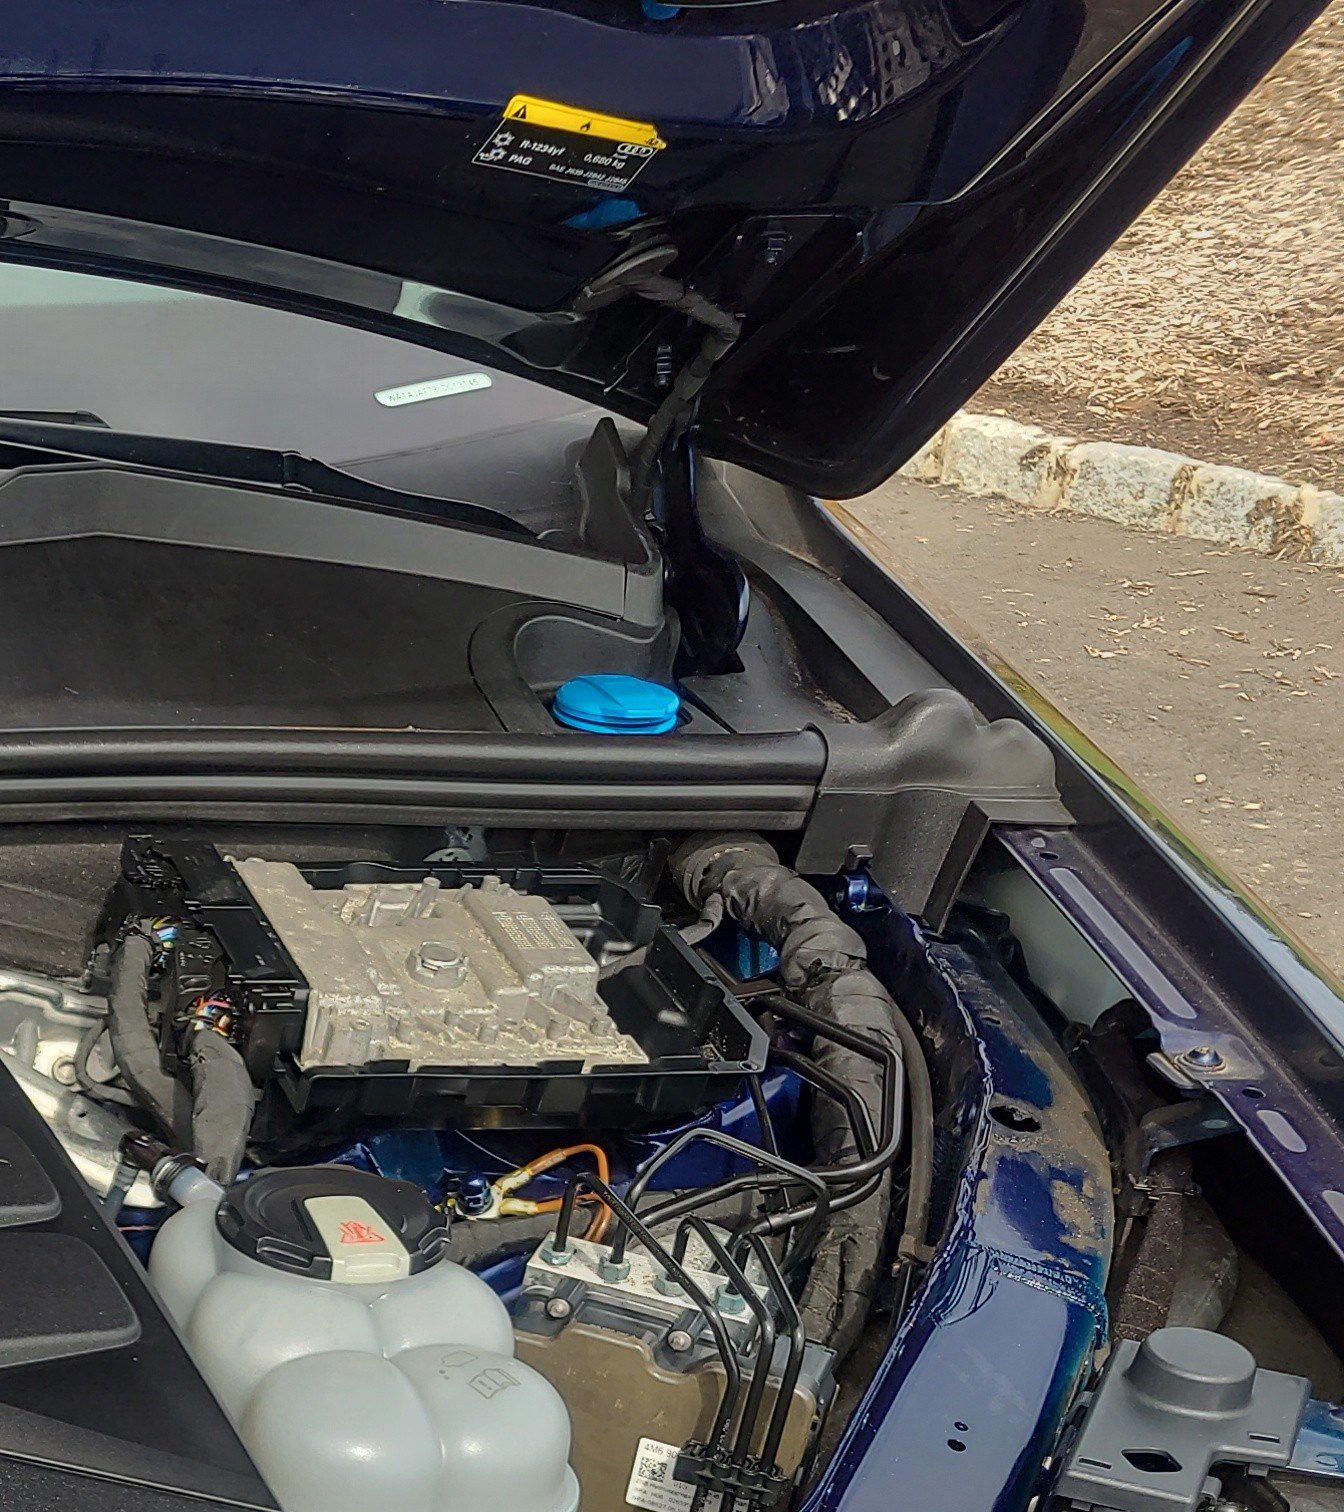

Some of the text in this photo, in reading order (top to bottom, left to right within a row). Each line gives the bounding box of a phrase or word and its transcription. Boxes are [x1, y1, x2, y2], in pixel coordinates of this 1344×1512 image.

[508, 155, 533, 166] PAG
[584, 153, 610, 166] 0,680
[611, 157, 626, 170] kg
